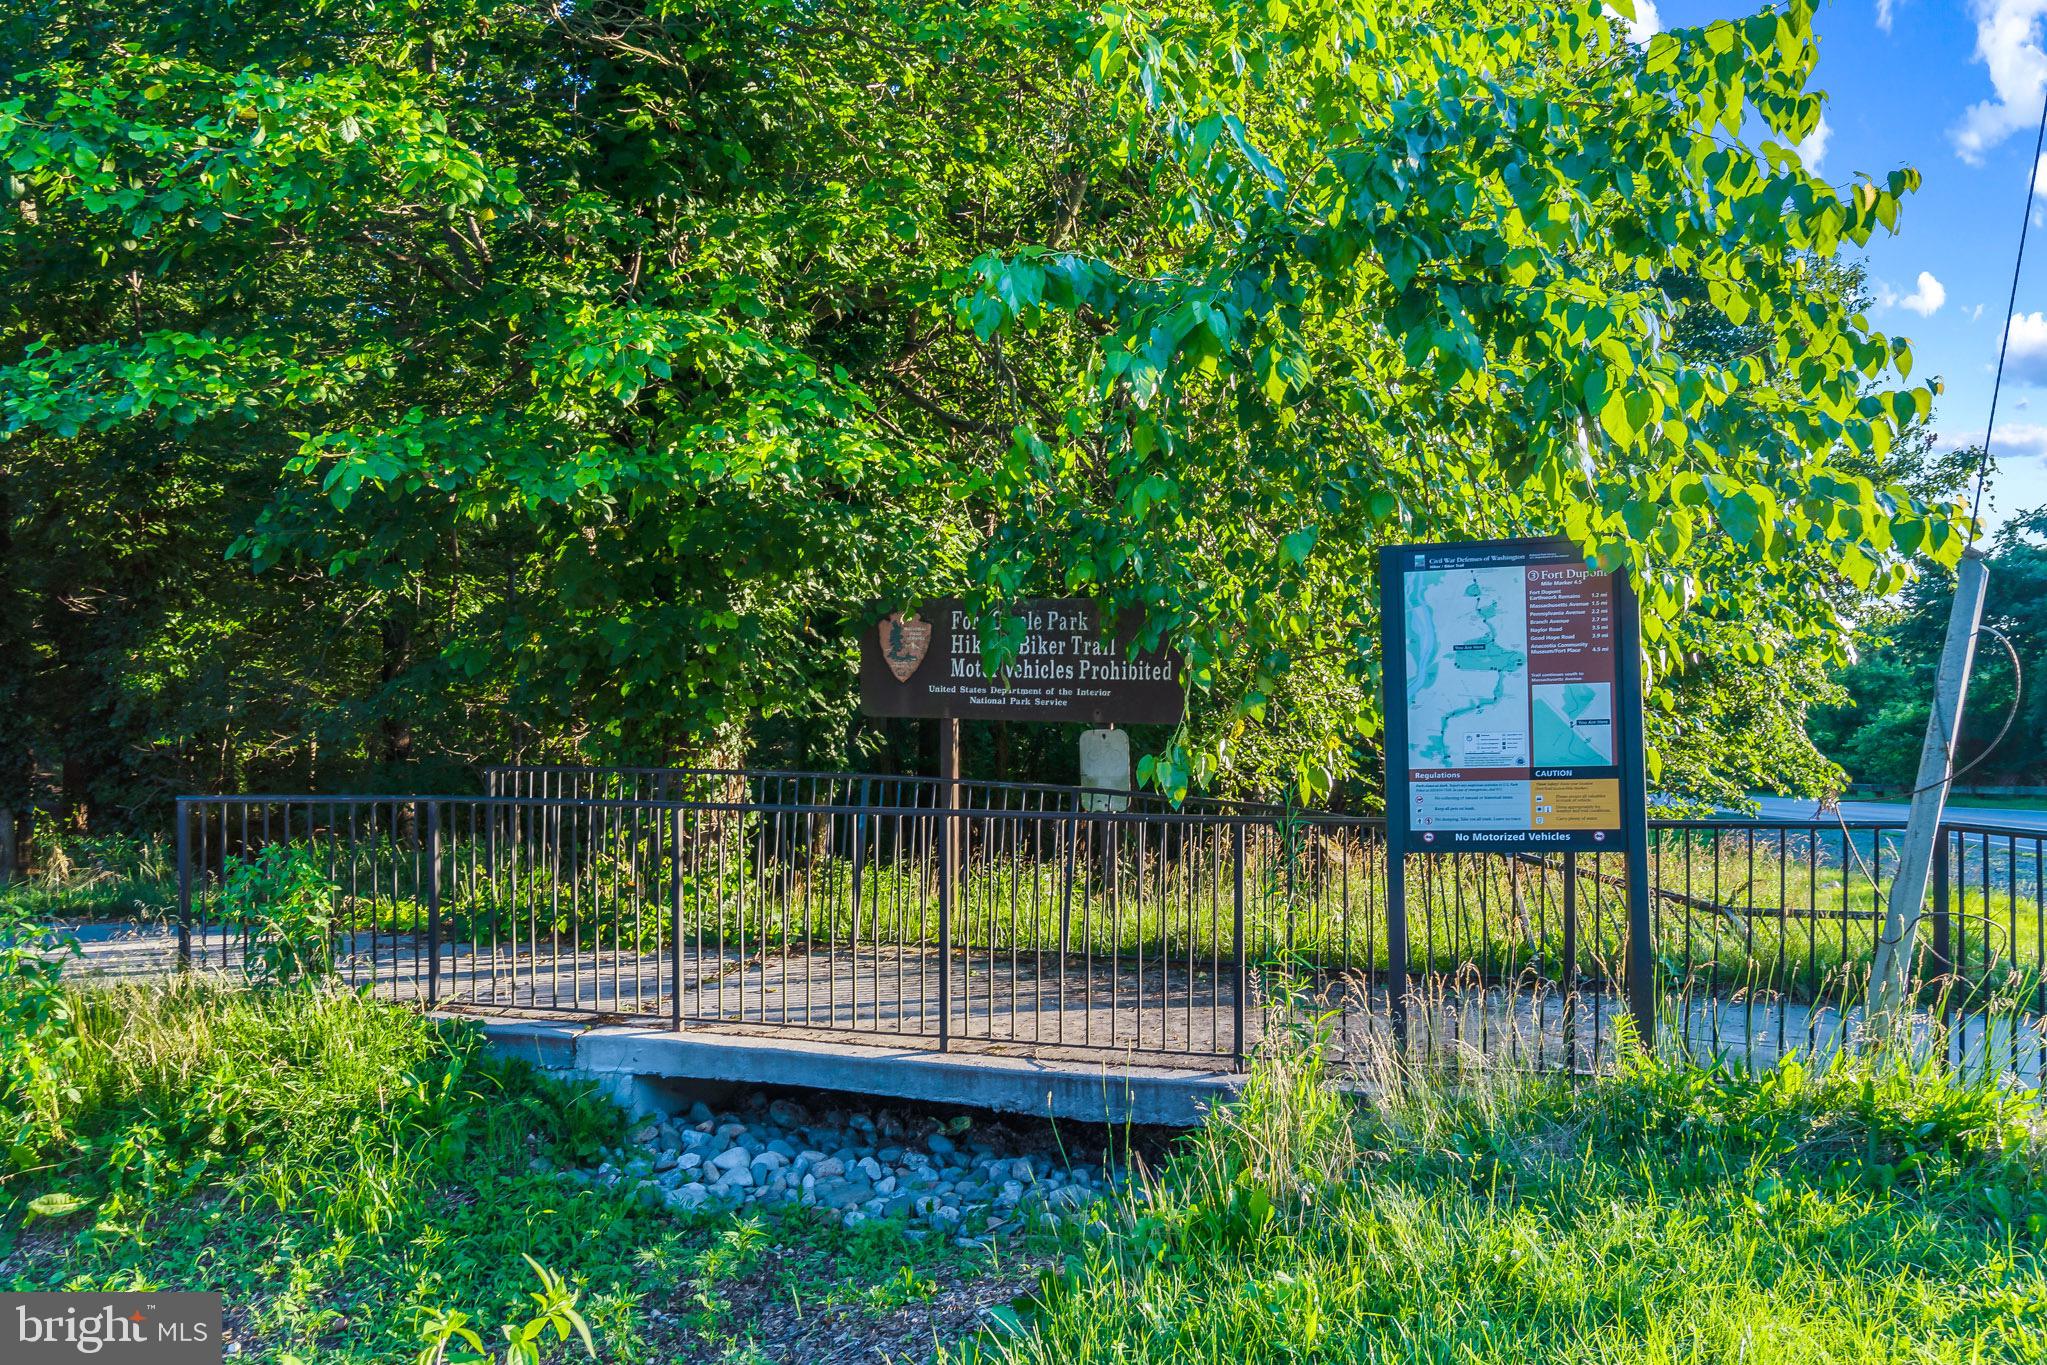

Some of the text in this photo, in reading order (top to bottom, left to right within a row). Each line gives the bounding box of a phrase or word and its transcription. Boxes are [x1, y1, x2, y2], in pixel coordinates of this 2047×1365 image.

[1541, 570, 1564, 579] Fort
[951, 610, 980, 630] For
[1047, 611, 1089, 631] Park
[951, 634, 983, 654] Hik
[1019, 634, 1066, 655] Biker
[950, 658, 997, 678] Mot
[1078, 660, 1172, 680] Prohibited
[928, 685, 956, 693] United
[959, 686, 987, 694] States
[1045, 687, 1056, 695] of
[1058, 688, 1073, 696] the
[1076, 688, 1112, 696] Interior
[969, 696, 1068, 706] National Park Service
[1415, 772, 1461, 780] Regulations
[1455, 832, 1571, 841] No Motorized Vehicles
